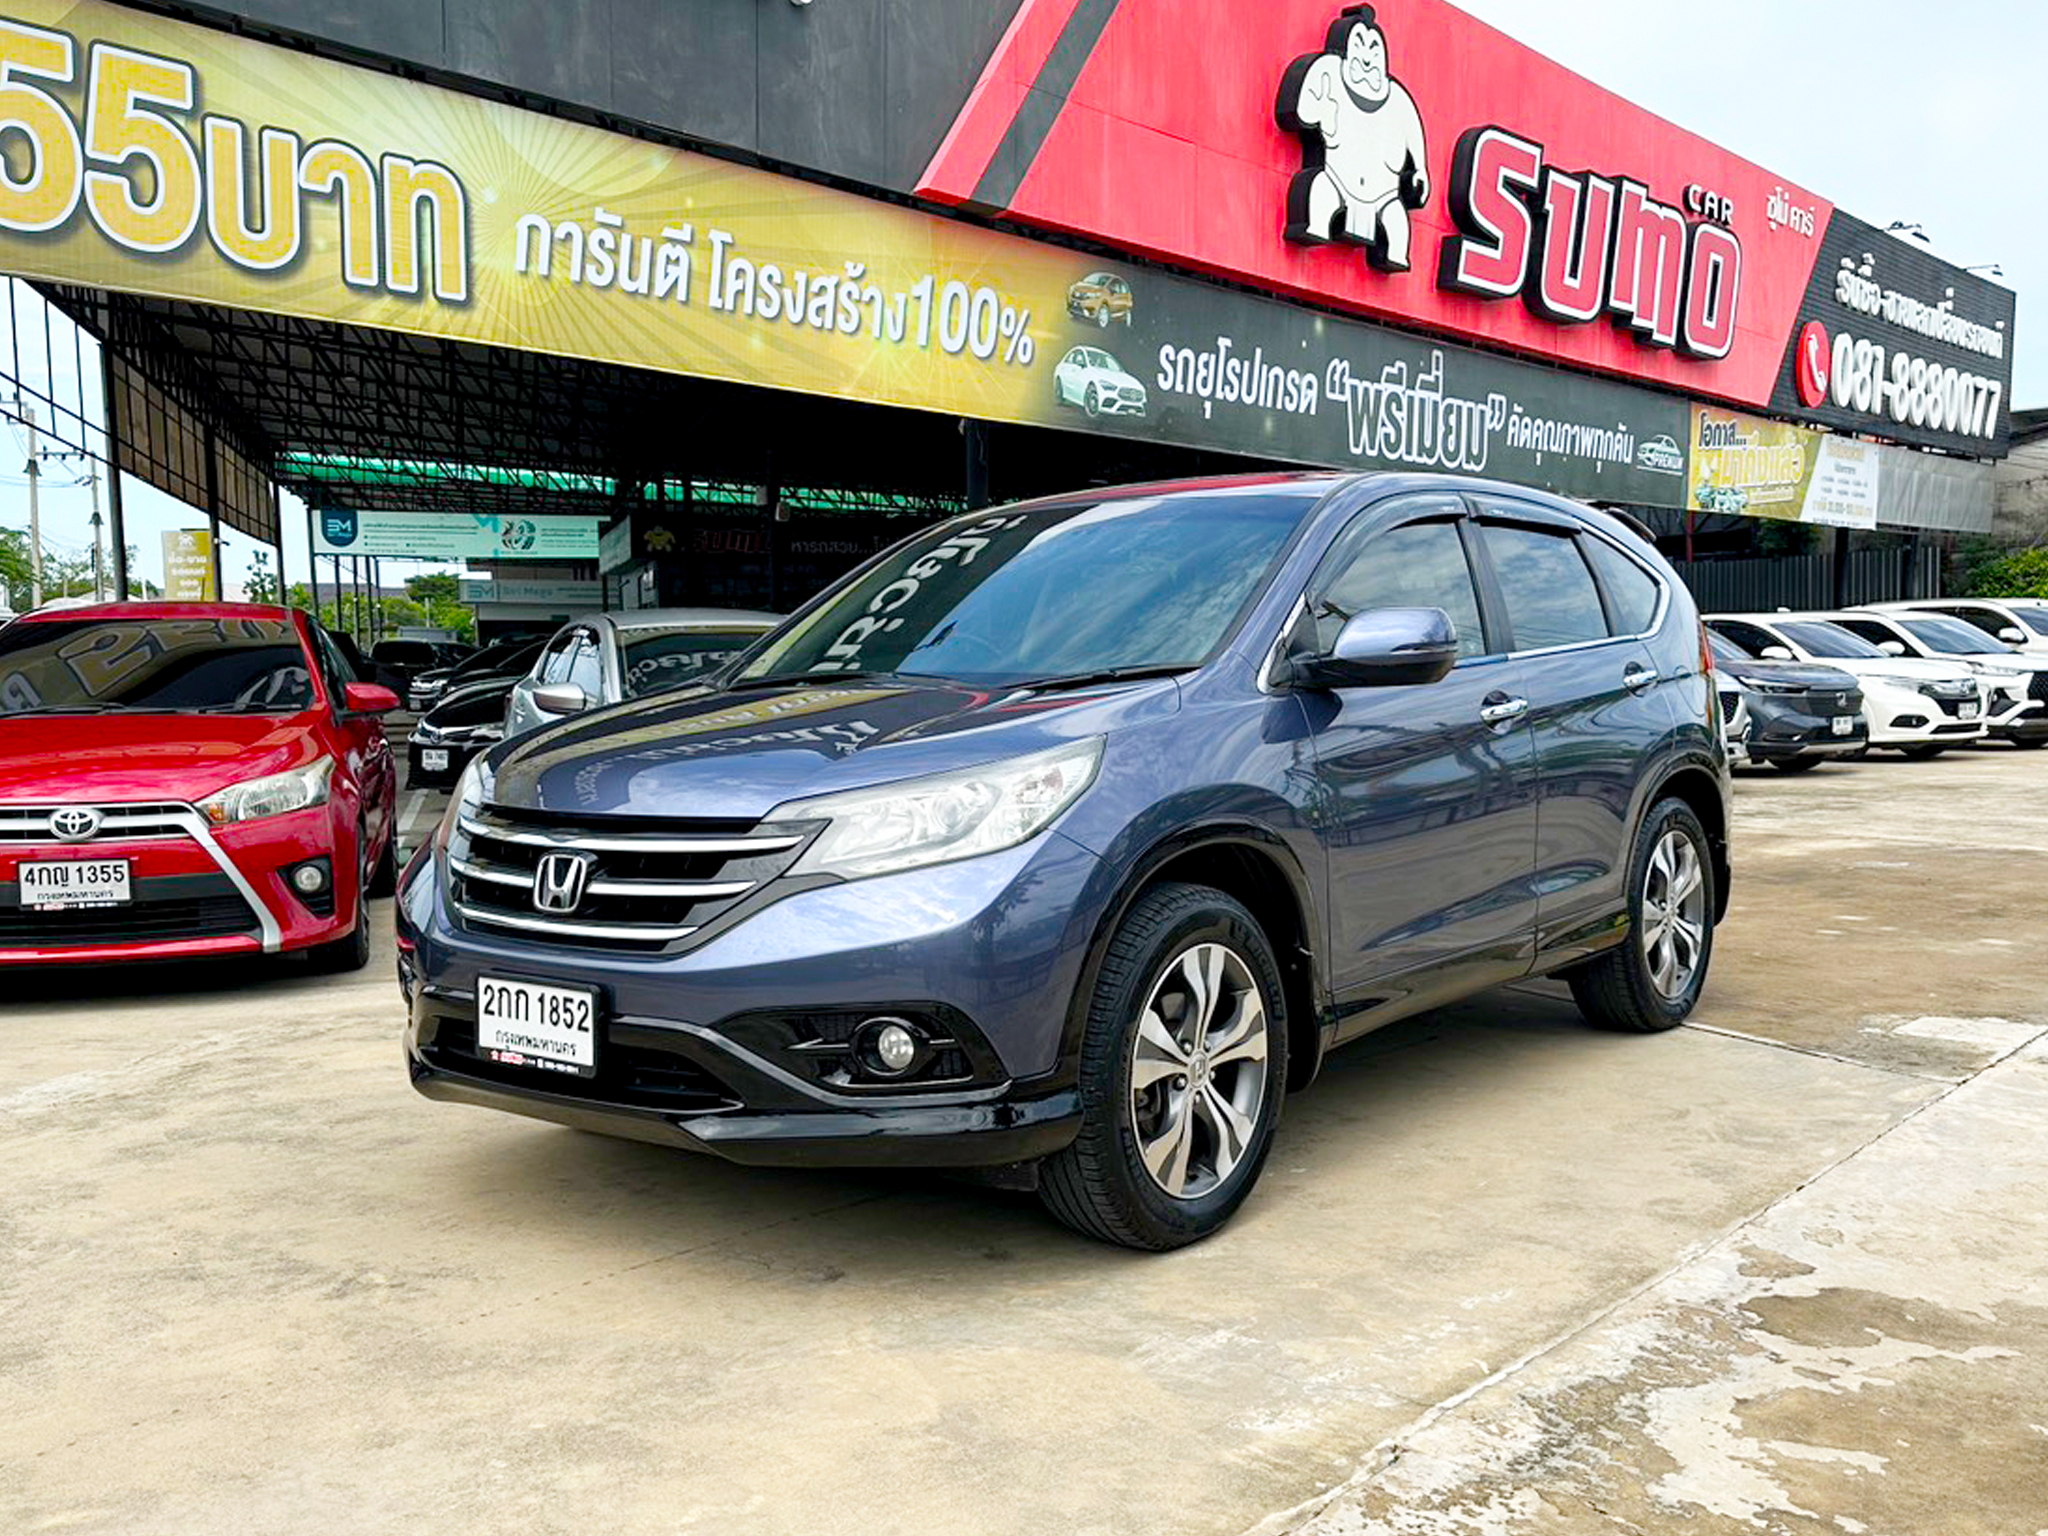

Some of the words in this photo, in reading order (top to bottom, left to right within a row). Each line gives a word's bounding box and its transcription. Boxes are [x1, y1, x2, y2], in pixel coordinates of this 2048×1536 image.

[1688, 184, 1734, 224] CAR
[514, 207, 692, 302] การันตี
[1158, 337, 1318, 418] รถยุโรปเกรด
[1507, 403, 1634, 474] คัดคุณภาพทุกคัน
[1831, 332, 2002, 440] 081-8880077
[24, 865, 70, 887] 4กญ
[76, 864, 125, 884] 1355
[484, 984, 529, 1021] 2กก
[537, 992, 590, 1033] 1852
